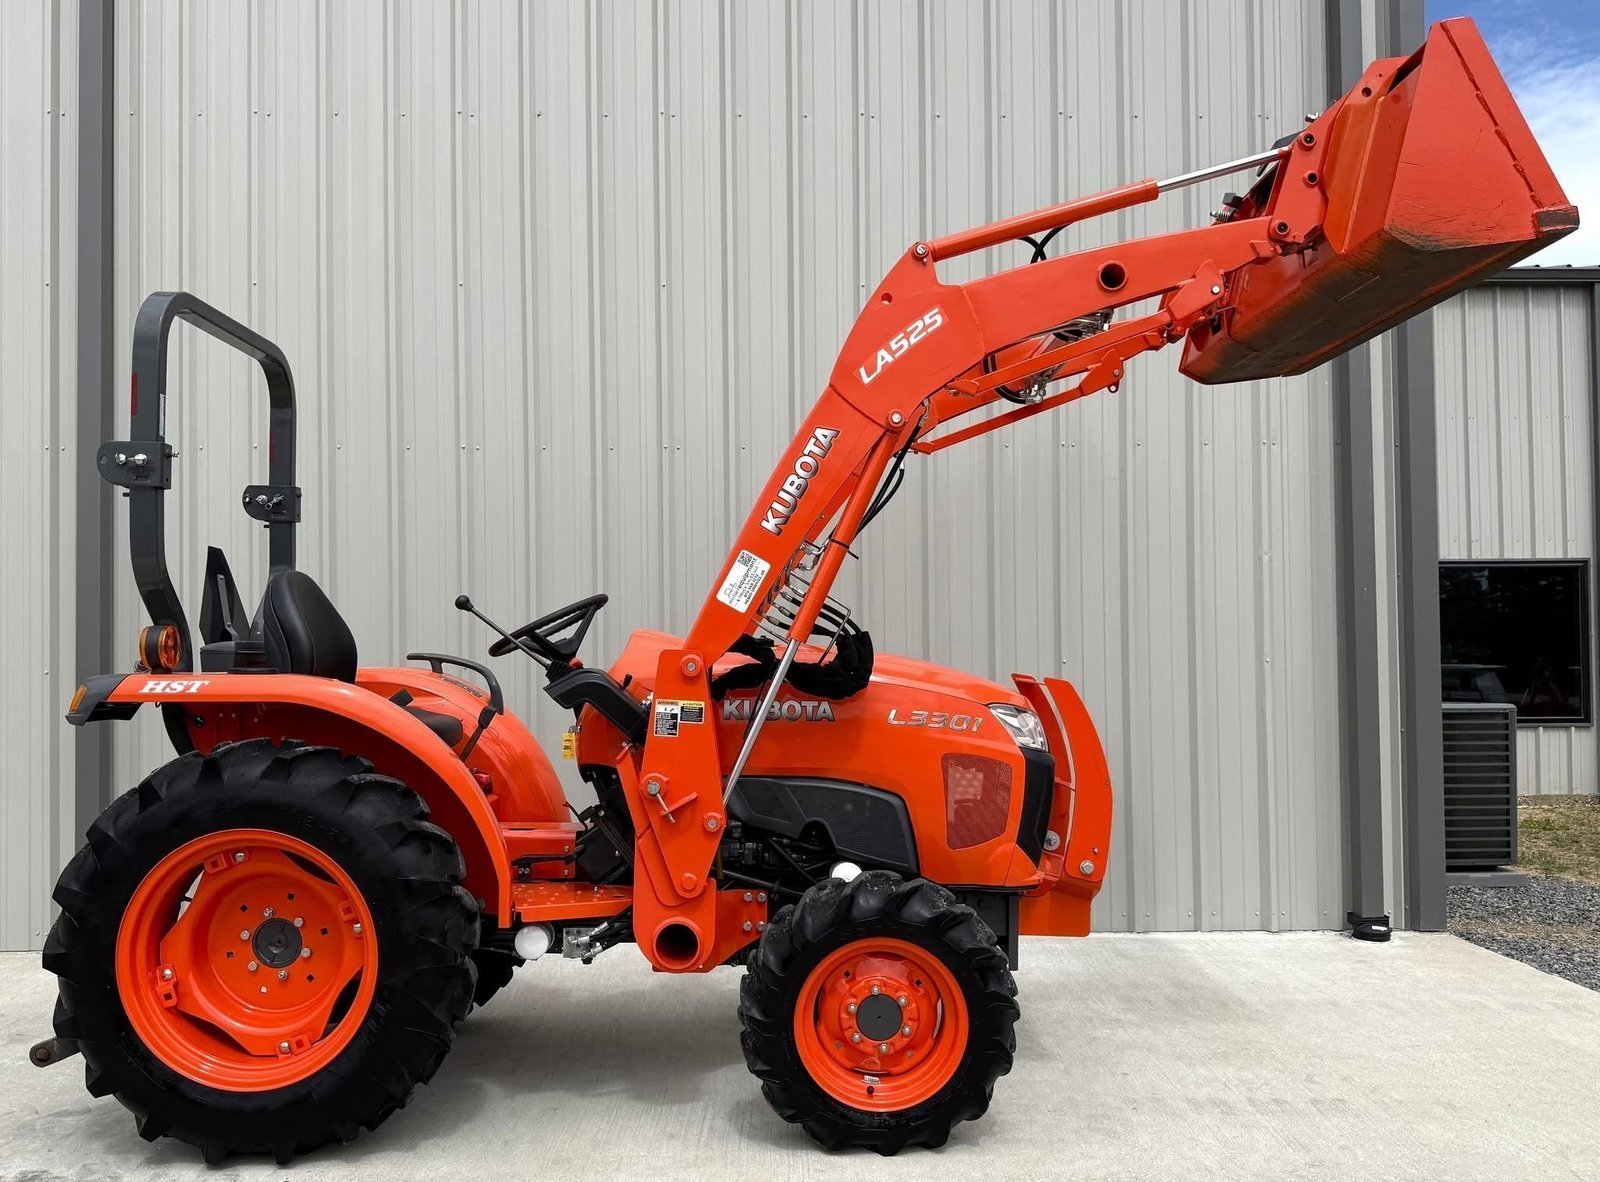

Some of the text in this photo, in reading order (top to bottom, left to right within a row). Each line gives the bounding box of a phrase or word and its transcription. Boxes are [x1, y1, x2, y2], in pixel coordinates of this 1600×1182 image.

[859, 307, 943, 385] LA525
[760, 426, 840, 536] KUBOTA
[138, 680, 210, 693] HST
[887, 708, 982, 732] L3301
